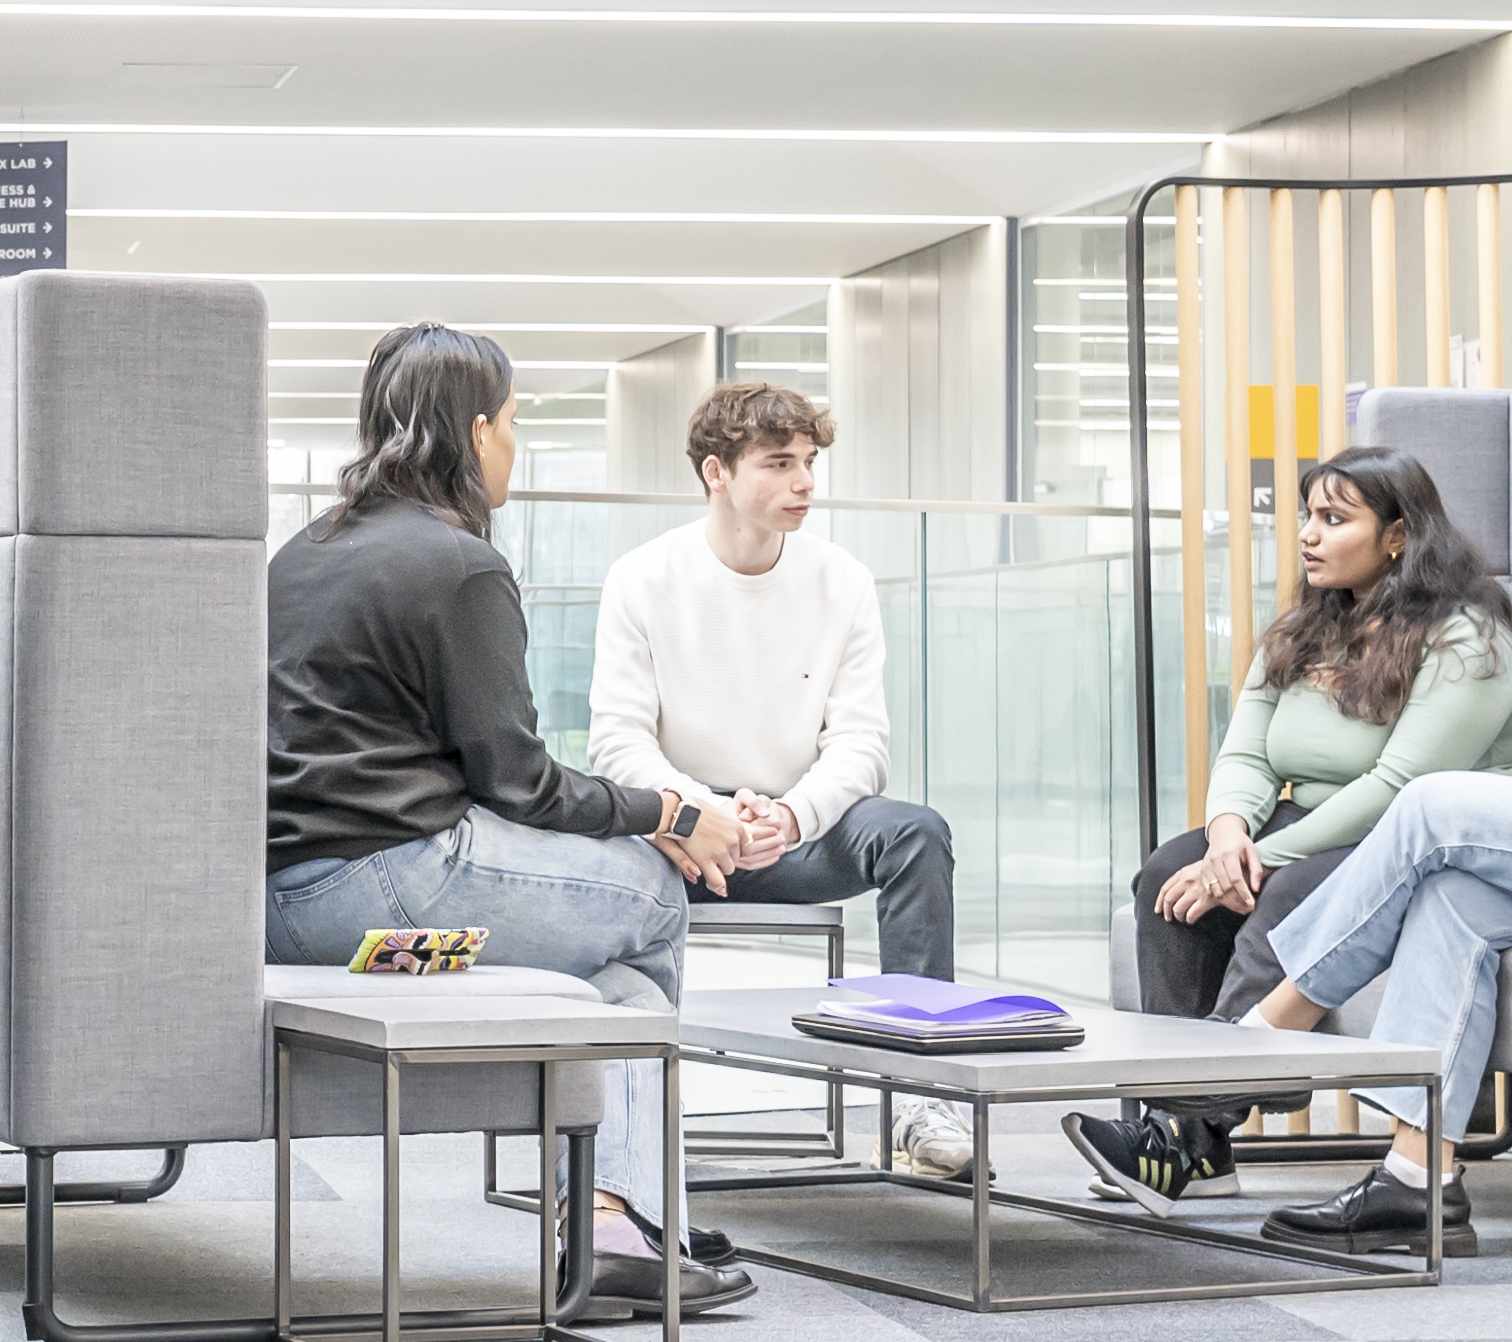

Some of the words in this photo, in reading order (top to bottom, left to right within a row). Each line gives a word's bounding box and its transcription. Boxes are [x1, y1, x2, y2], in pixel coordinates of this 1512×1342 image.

[10, 158, 36, 169] LAB
[26, 184, 36, 195] &
[9, 197, 36, 208] HUB
[0, 222, 36, 234] SUITE
